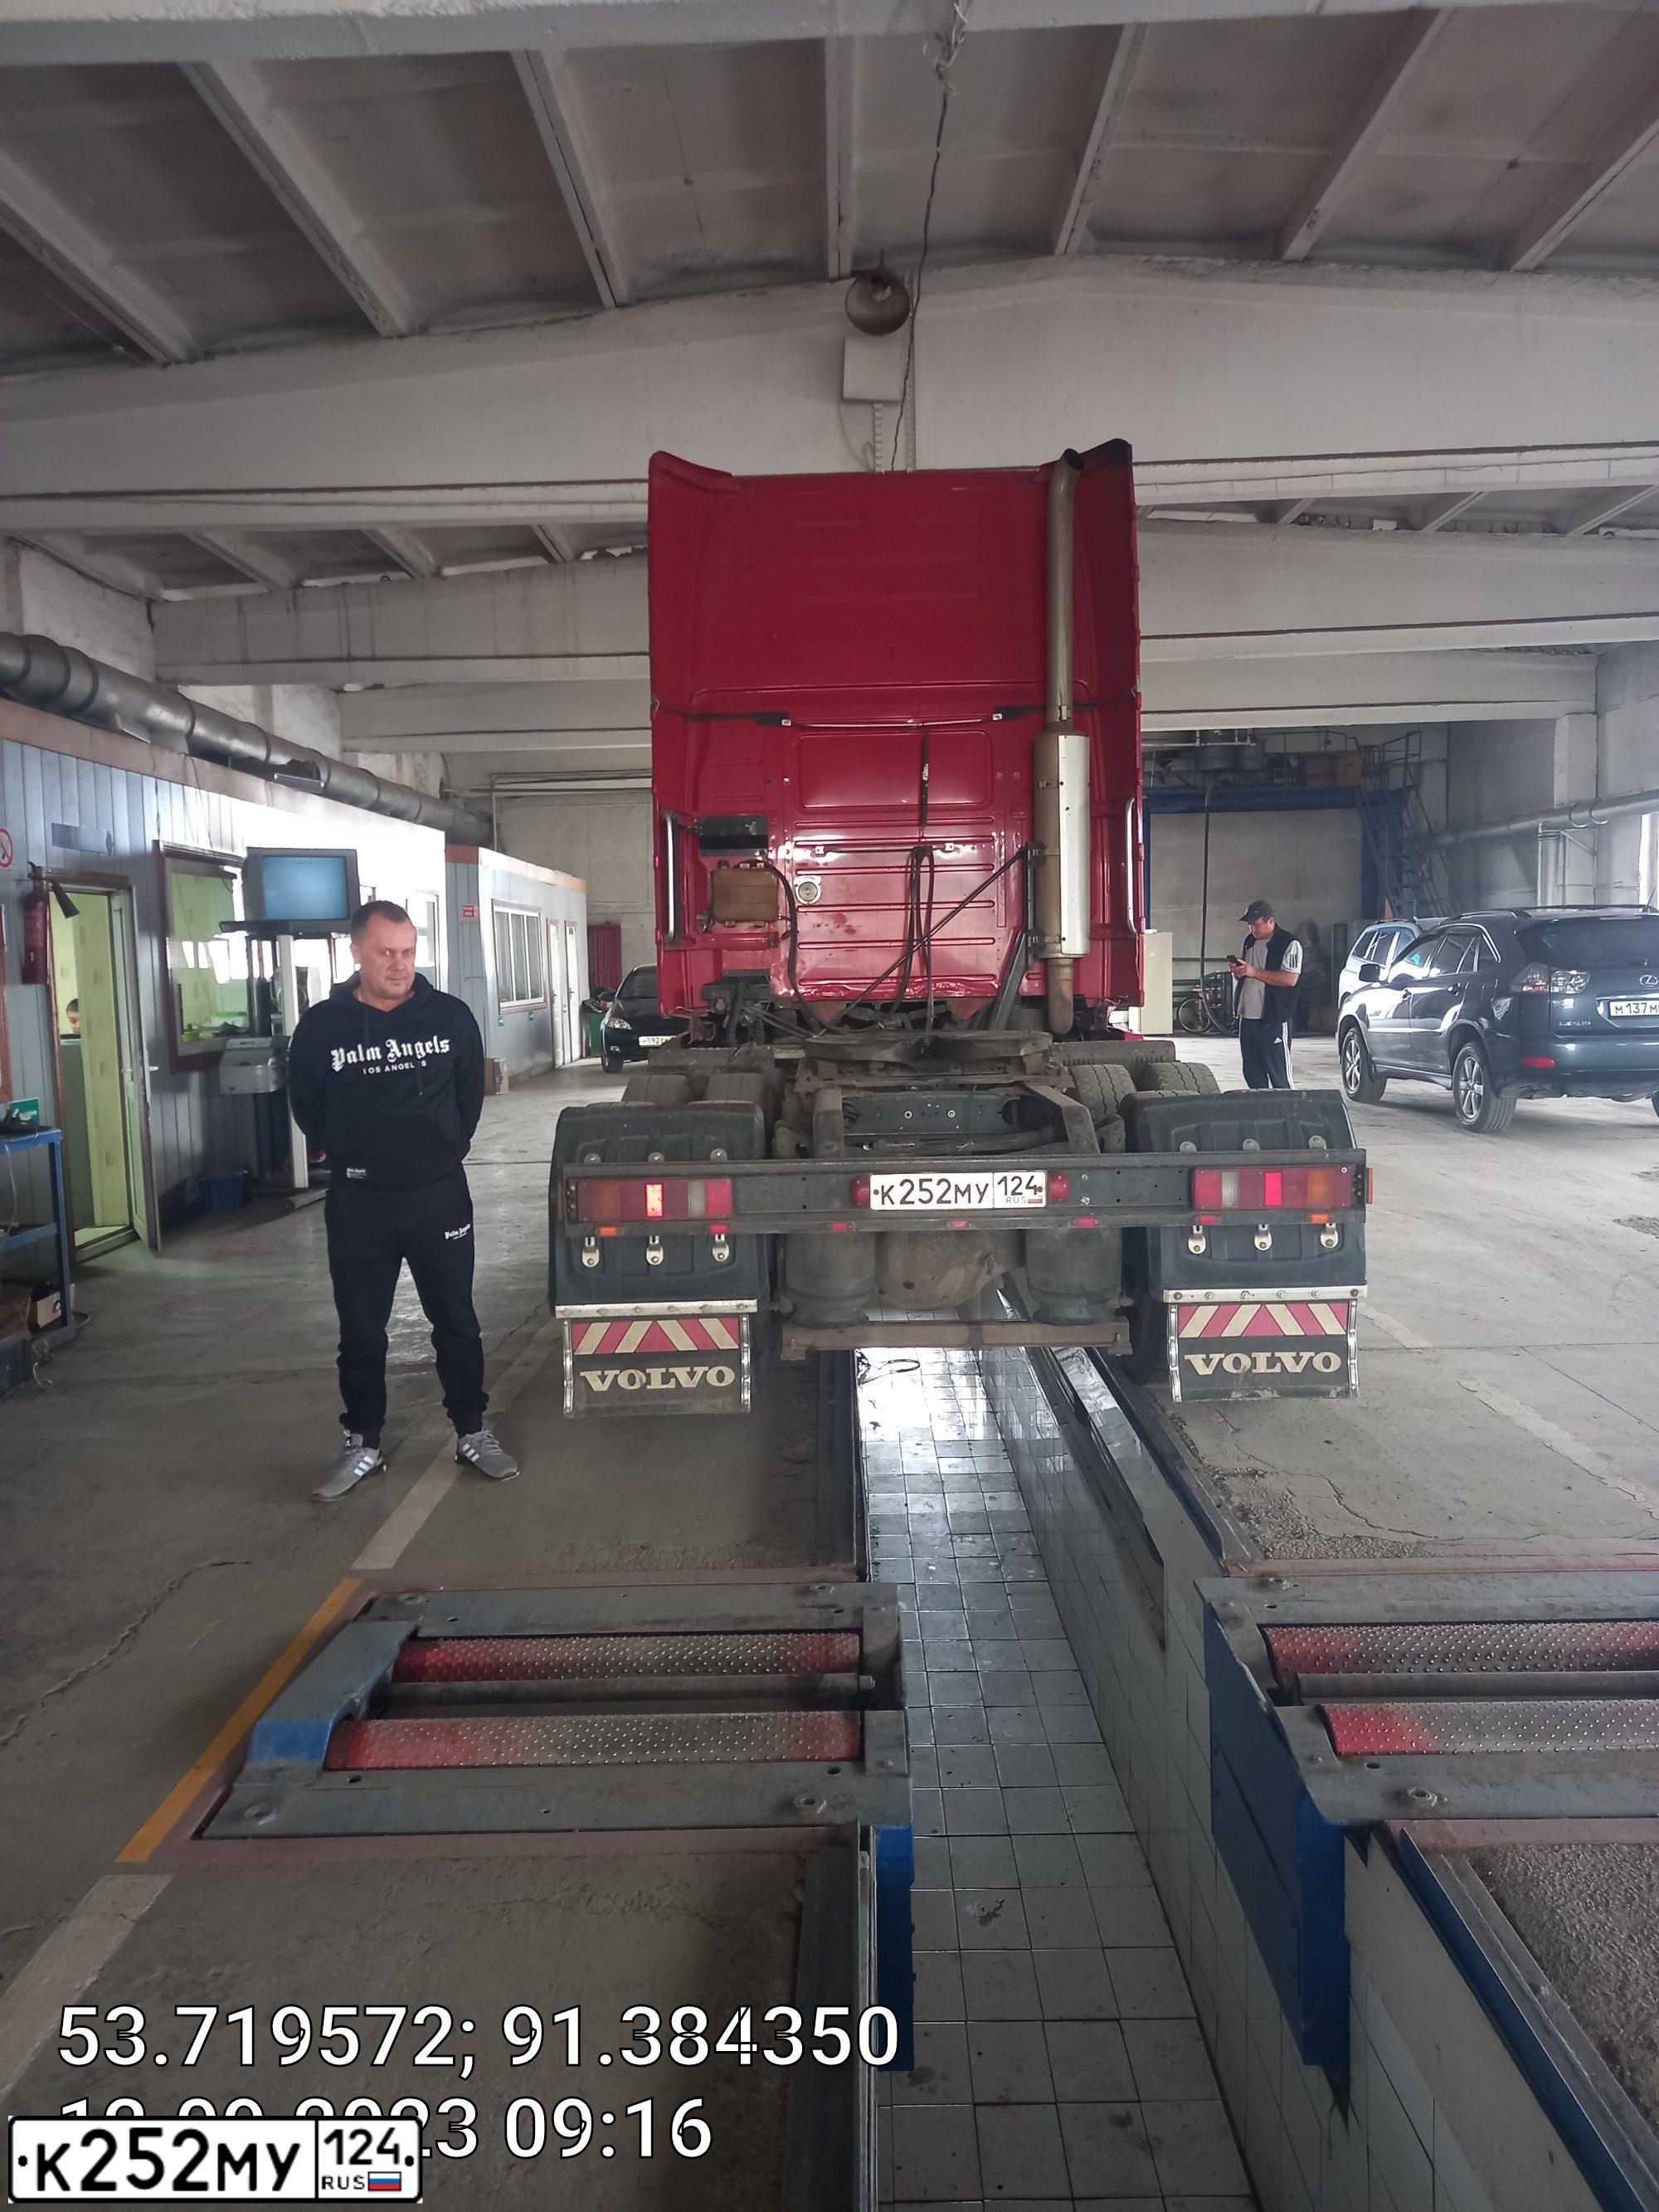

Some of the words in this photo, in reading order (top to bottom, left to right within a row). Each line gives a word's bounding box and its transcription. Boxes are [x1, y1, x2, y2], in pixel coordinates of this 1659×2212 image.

[1614, 1002, 1659, 1014] М137М
[331, 1044, 382, 1072] Palm
[386, 1035, 450, 1063] Angels
[384, 1060, 427, 1072] ANGELS
[881, 1178, 989, 1205] К252МУ
[997, 1175, 1038, 1196] 124
[1184, 1352, 1341, 1376] VOLVO
[579, 1366, 735, 1391] VOLVO
